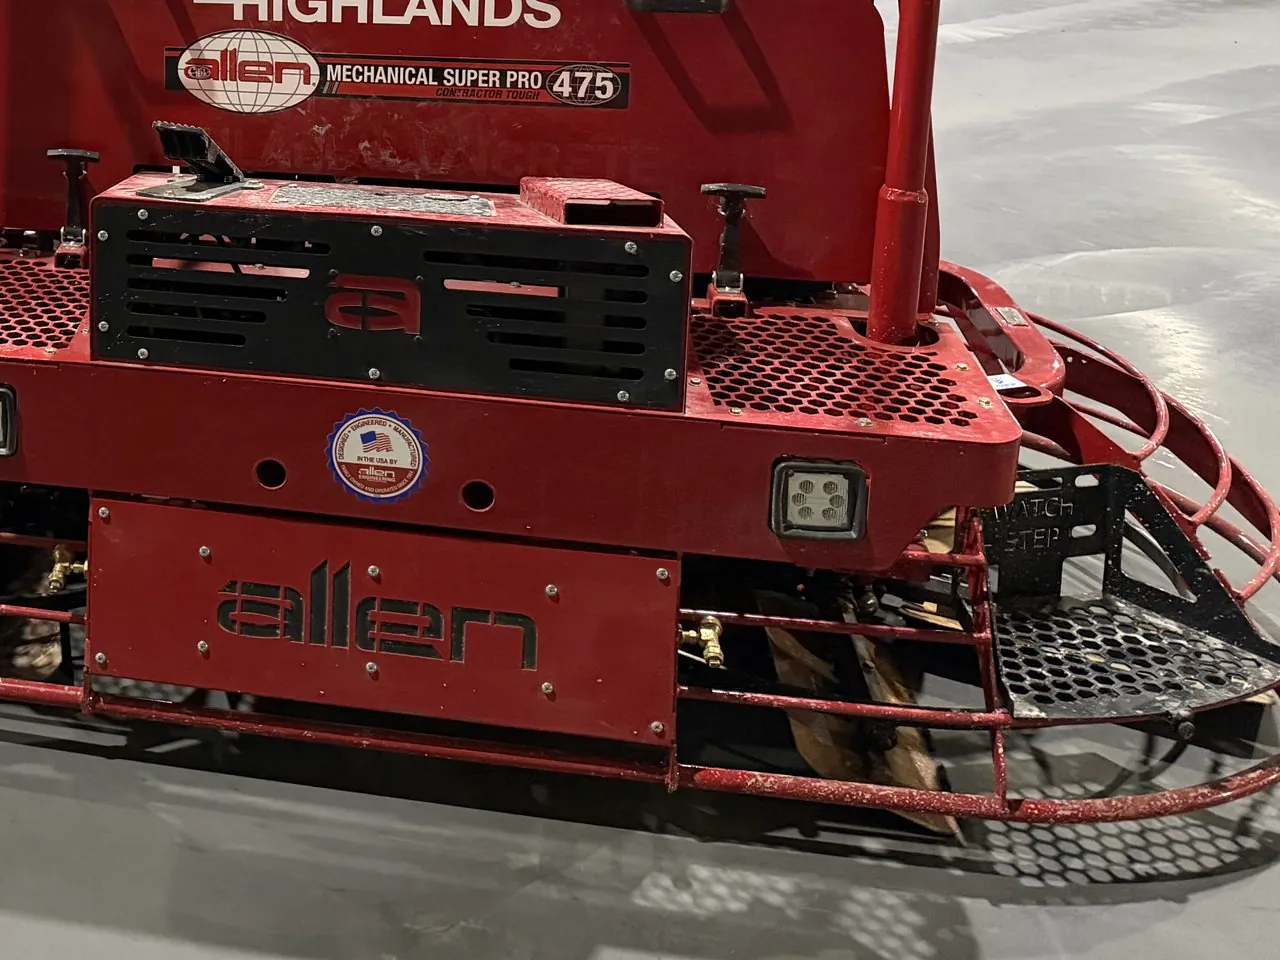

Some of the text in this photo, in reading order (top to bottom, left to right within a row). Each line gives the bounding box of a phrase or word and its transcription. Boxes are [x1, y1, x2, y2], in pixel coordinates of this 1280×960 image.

[183, 47, 311, 86] allen
[325, 64, 543, 90] MECHANICAL SUPER PRO
[435, 87, 540, 100] CONTRACTOR TOUGH
[552, 71, 615, 100] 475
[338, 419, 418, 468] DESIGNED ENGINEERED MANUFACTURED
[358, 465, 395, 478] allen
[375, 457, 389, 465] USA
[991, 497, 1075, 523] WATCH
[1004, 527, 1060, 552] STEP
[216, 559, 539, 672] allen
